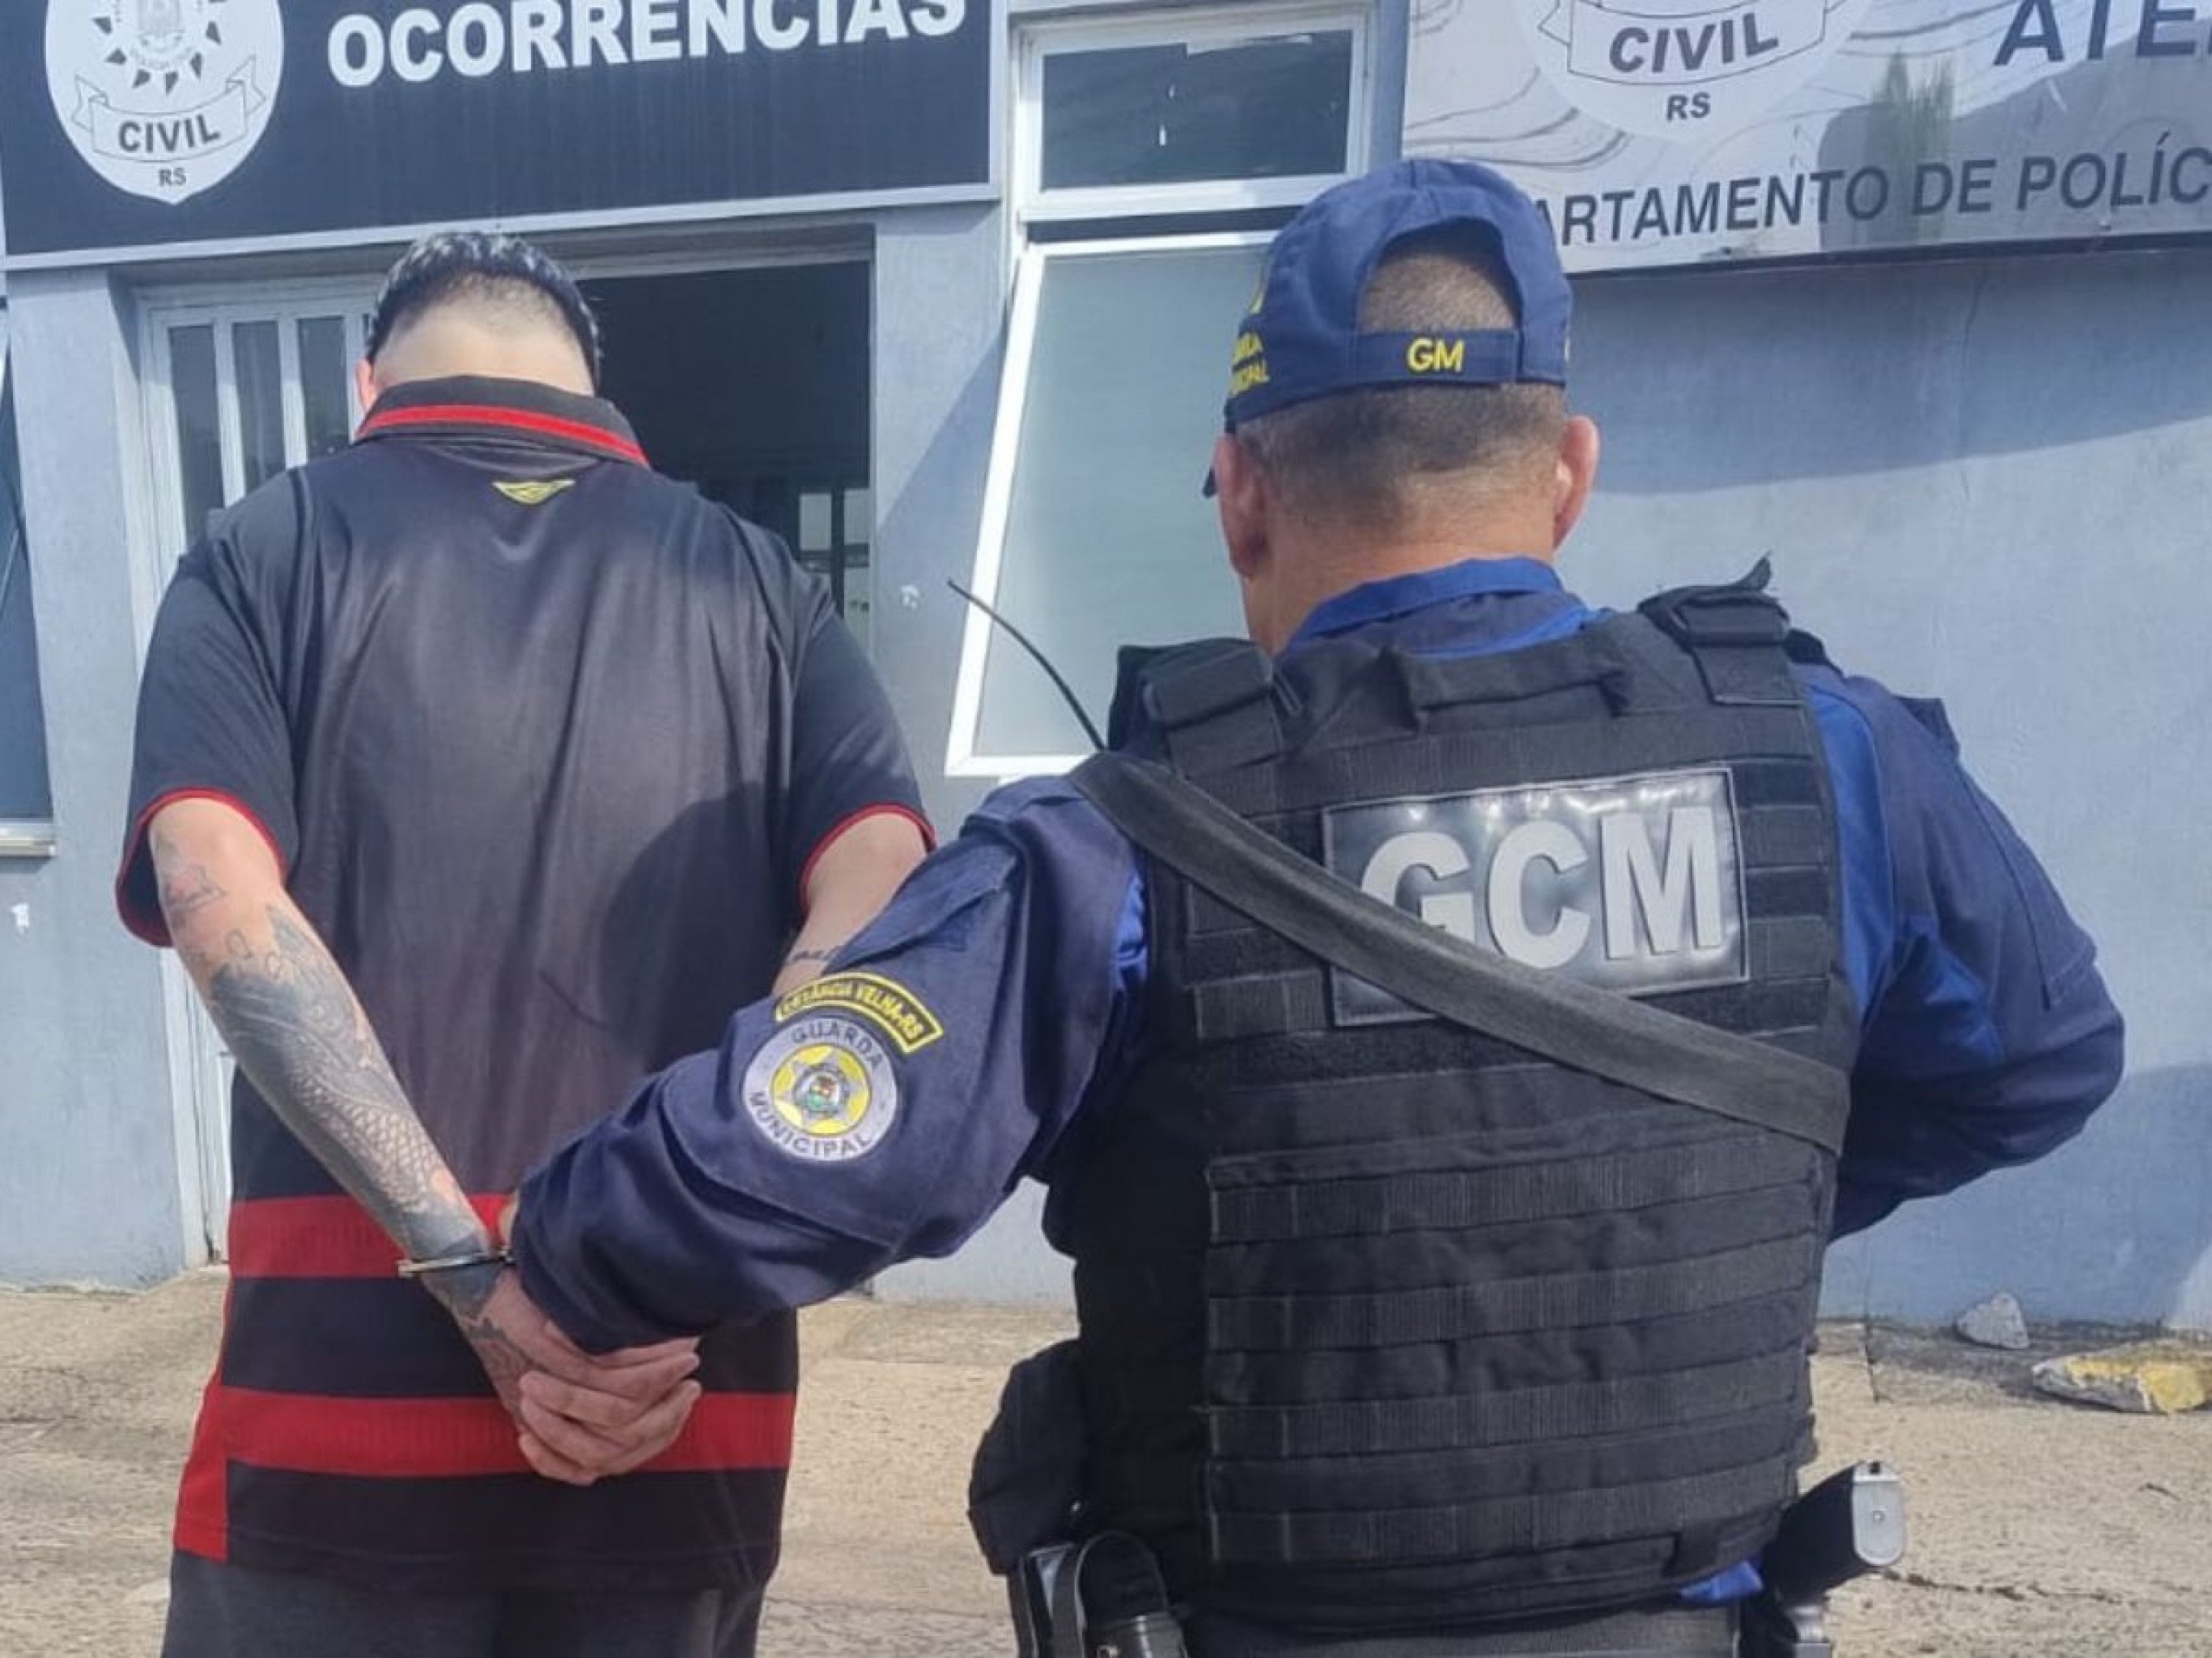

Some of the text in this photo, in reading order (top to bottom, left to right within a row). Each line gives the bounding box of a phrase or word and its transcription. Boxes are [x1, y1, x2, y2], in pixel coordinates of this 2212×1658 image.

[1609, 12, 1780, 73] CIVIL
[1666, 92, 1711, 121] RS
[118, 114, 220, 154] CIVIL
[158, 167, 187, 187] RS
[1913, 160, 1993, 215] DE
[1407, 337, 1466, 373] GM
[1361, 807, 1722, 969] GCM
[790, 1021, 884, 1067] GUARDA
[749, 1090, 873, 1157] MUNICIPAL
